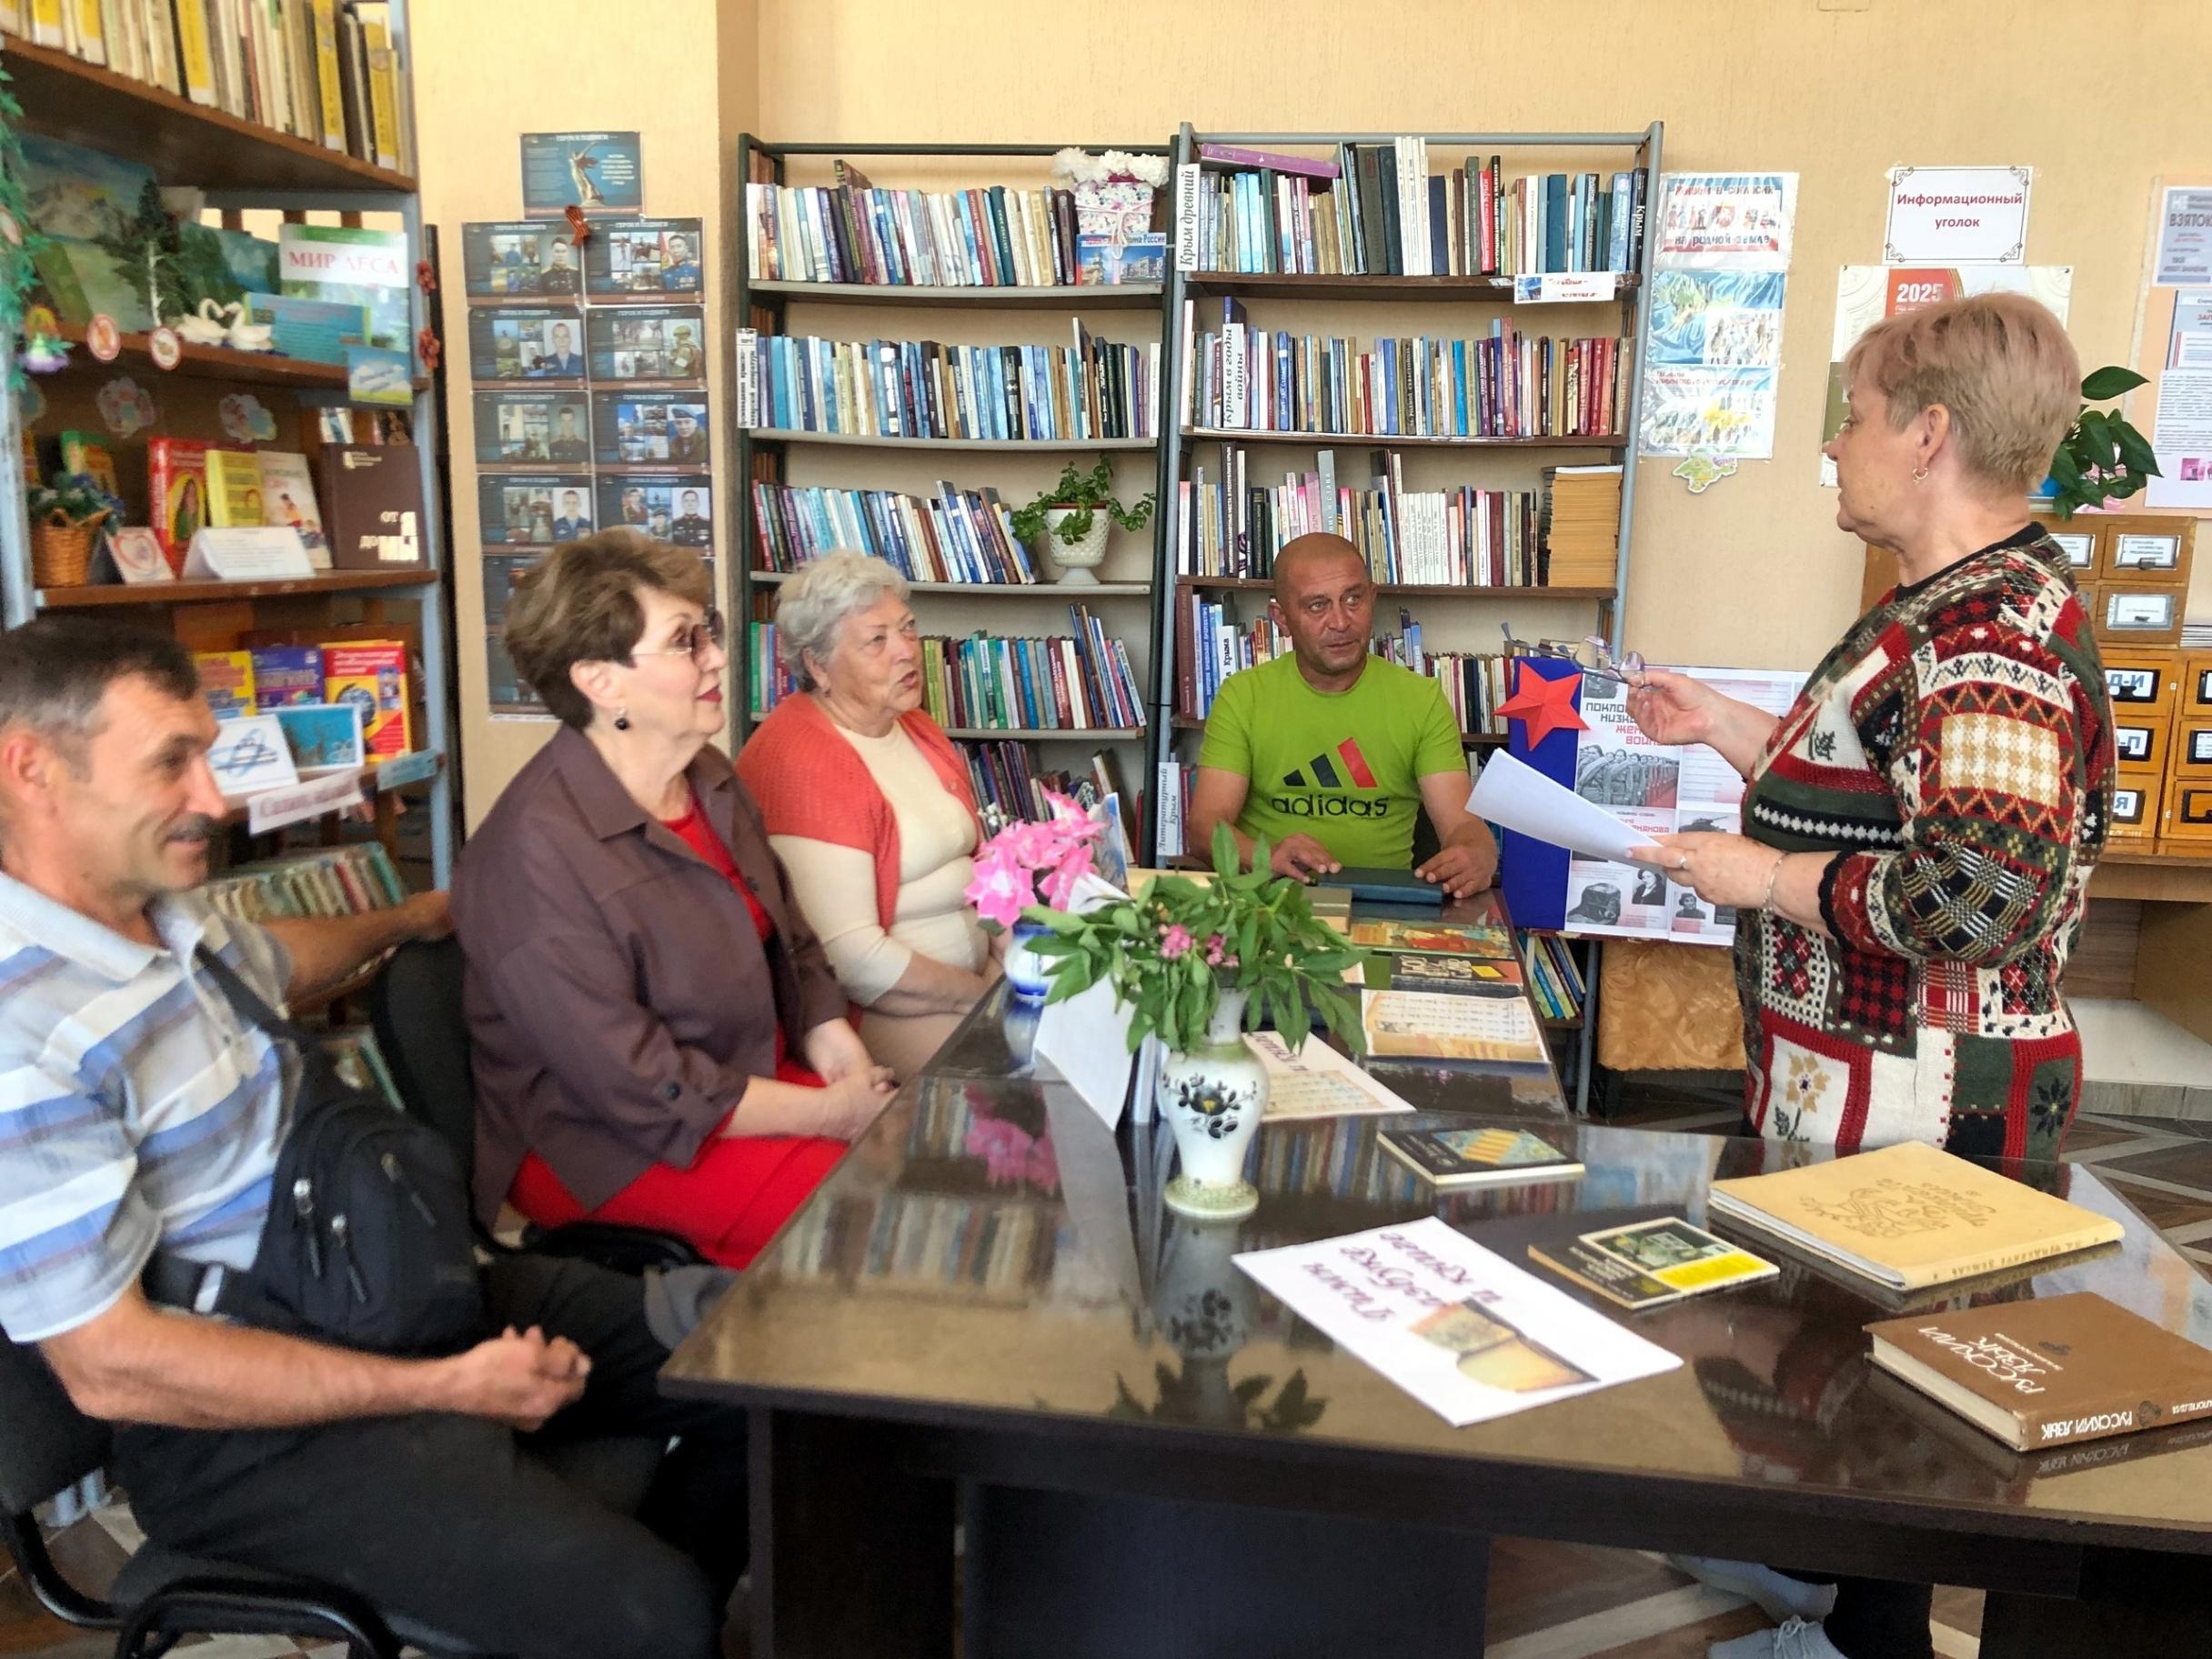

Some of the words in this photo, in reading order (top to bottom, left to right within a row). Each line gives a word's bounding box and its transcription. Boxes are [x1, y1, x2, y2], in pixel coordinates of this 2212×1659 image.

[1180, 170, 1197, 224] древний
[1896, 192, 2023, 209] Информационный
[1633, 206, 1645, 236] Крым
[1934, 216, 1981, 231] уголок
[1180, 226, 1195, 266] Крым
[287, 251, 336, 269] МИР
[346, 256, 399, 275] ЛЕСА
[1895, 283, 1943, 303] 2025
[1224, 327, 1233, 364] годы
[1225, 368, 1232, 377] в
[1235, 352, 1243, 400] войны
[1223, 380, 1233, 423] Крым
[1223, 638, 1232, 666] Крыма
[1585, 701, 1627, 714] ПОКЛО
[1615, 725, 1643, 734] ЖЕН
[1159, 768, 1168, 851] Литературный
[1168, 795, 1178, 824] Крым
[1272, 792, 1391, 819] adidas
[1917, 1326, 2046, 1395] РУССКИЙ
[1969, 1336, 2046, 1375] ЯЗЫК
[2041, 1419, 2074, 1440] ЯЗЫК
[2076, 1411, 2133, 1436] РУССКИЙ
